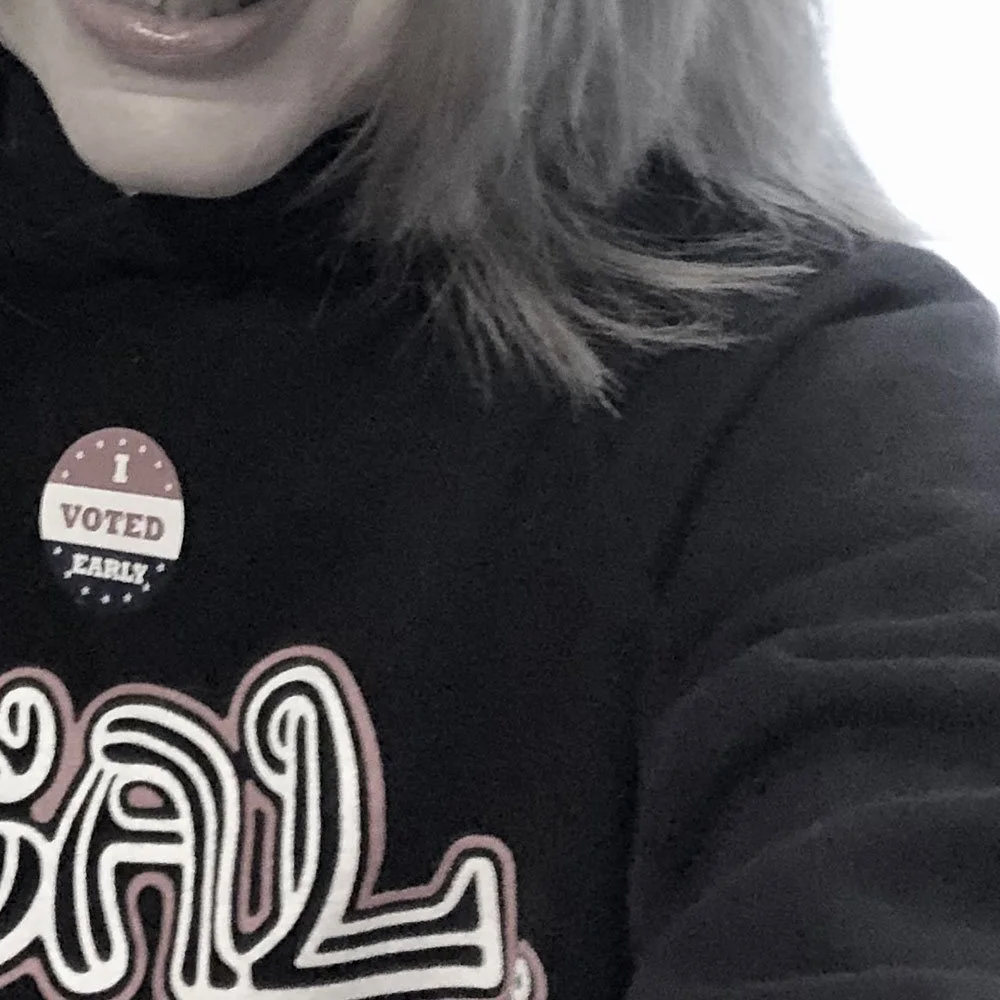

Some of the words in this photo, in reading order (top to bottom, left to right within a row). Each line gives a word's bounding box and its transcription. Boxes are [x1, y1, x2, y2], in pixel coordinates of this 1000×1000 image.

[111, 453, 131, 484] I
[60, 503, 165, 541] VOTED
[71, 553, 149, 585] EARLY
